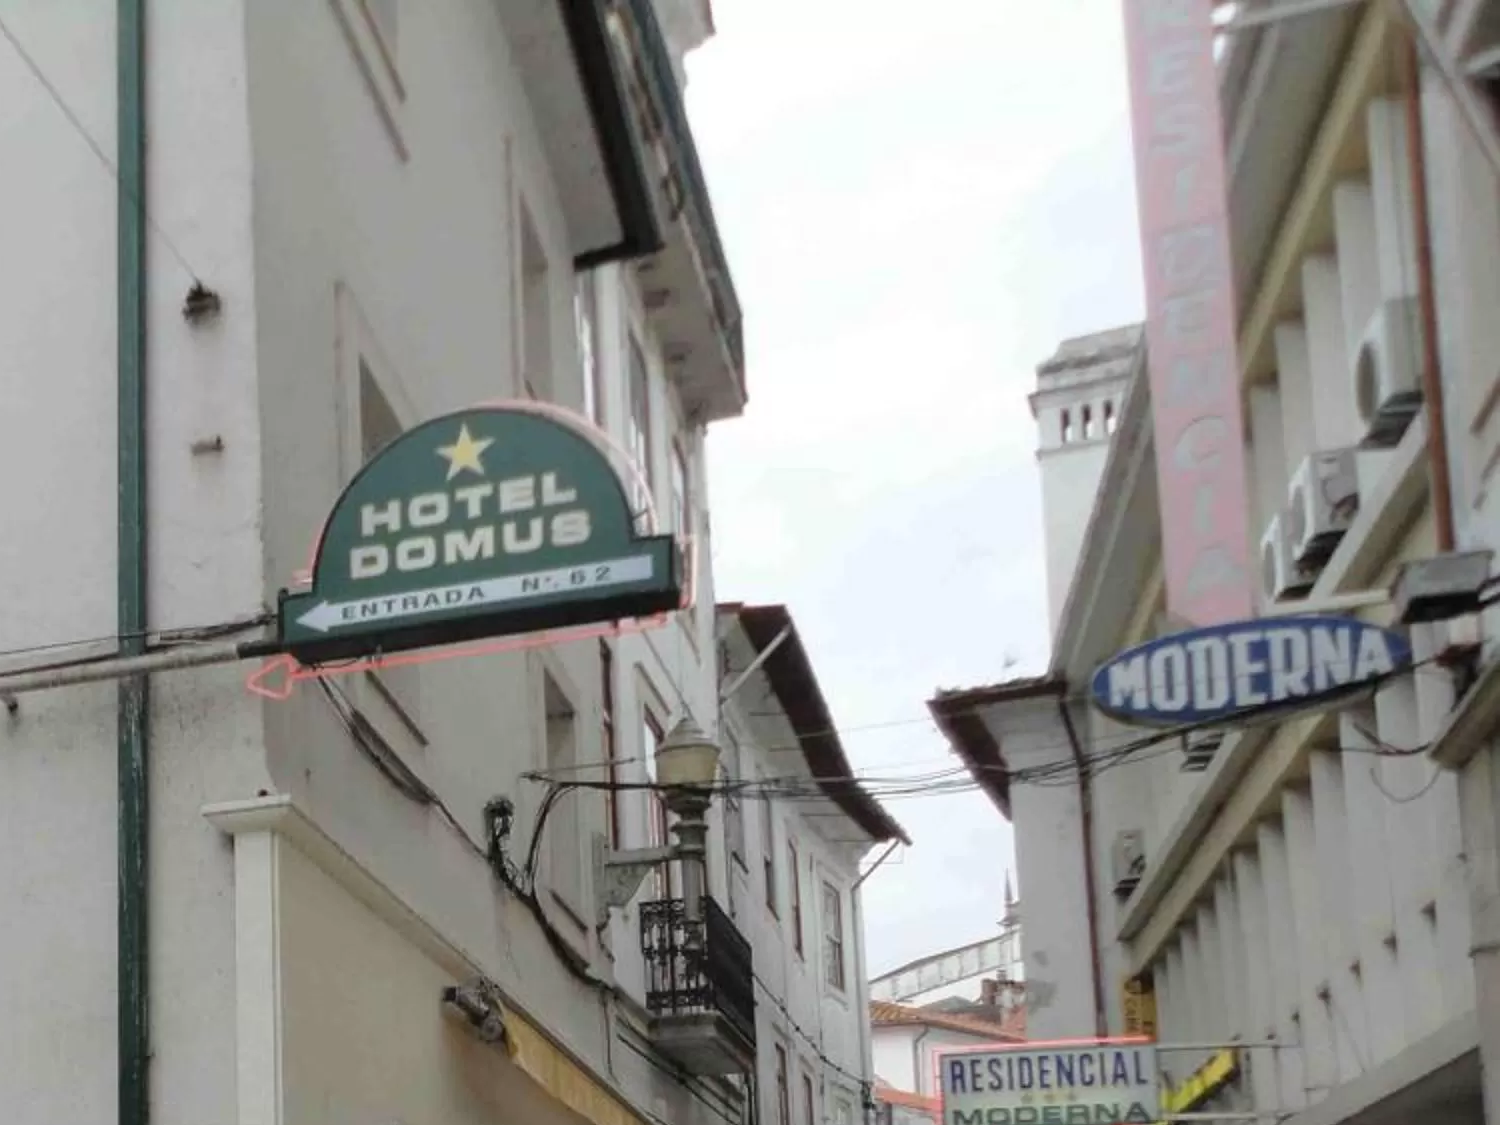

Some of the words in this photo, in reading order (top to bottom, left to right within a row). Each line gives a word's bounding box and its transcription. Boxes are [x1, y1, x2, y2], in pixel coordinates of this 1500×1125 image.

[360, 471, 577, 537] HOTEL
[349, 510, 592, 579] DOMUS
[341, 585, 487, 621] ENTRADA
[1108, 626, 1394, 713] MODERNA
[950, 1051, 1149, 1095] RESIDENCIAL
